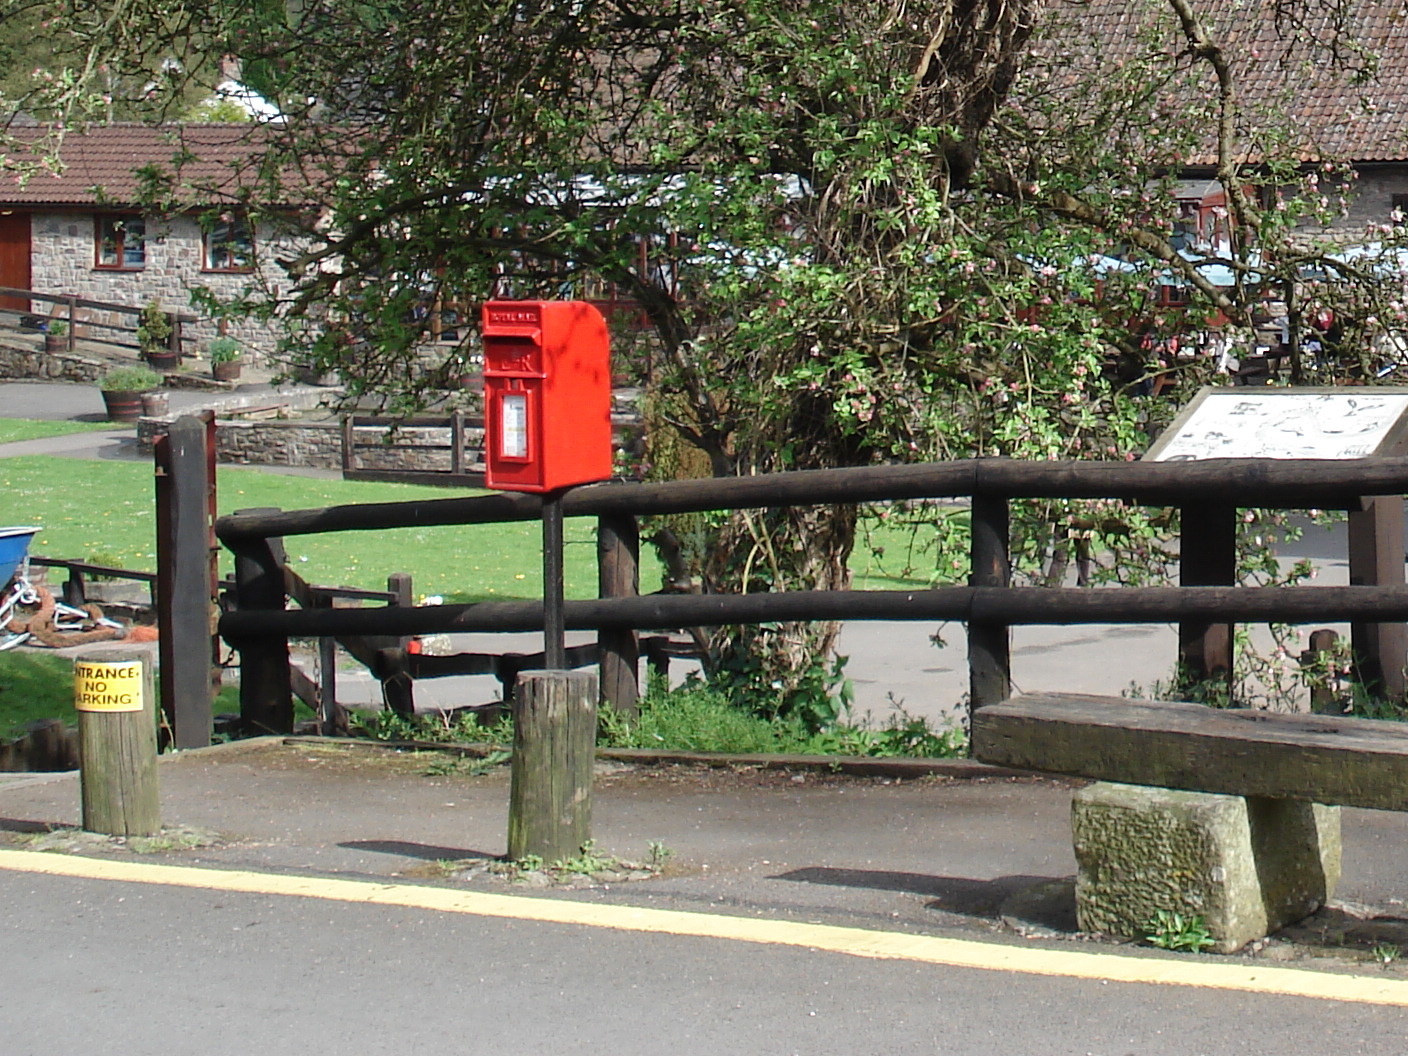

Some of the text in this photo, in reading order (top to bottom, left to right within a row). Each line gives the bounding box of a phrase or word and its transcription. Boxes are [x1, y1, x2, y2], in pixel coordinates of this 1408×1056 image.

[75, 666, 134, 679] NTRANCE
[85, 681, 107, 692] NO
[77, 693, 132, 704] ARKING
